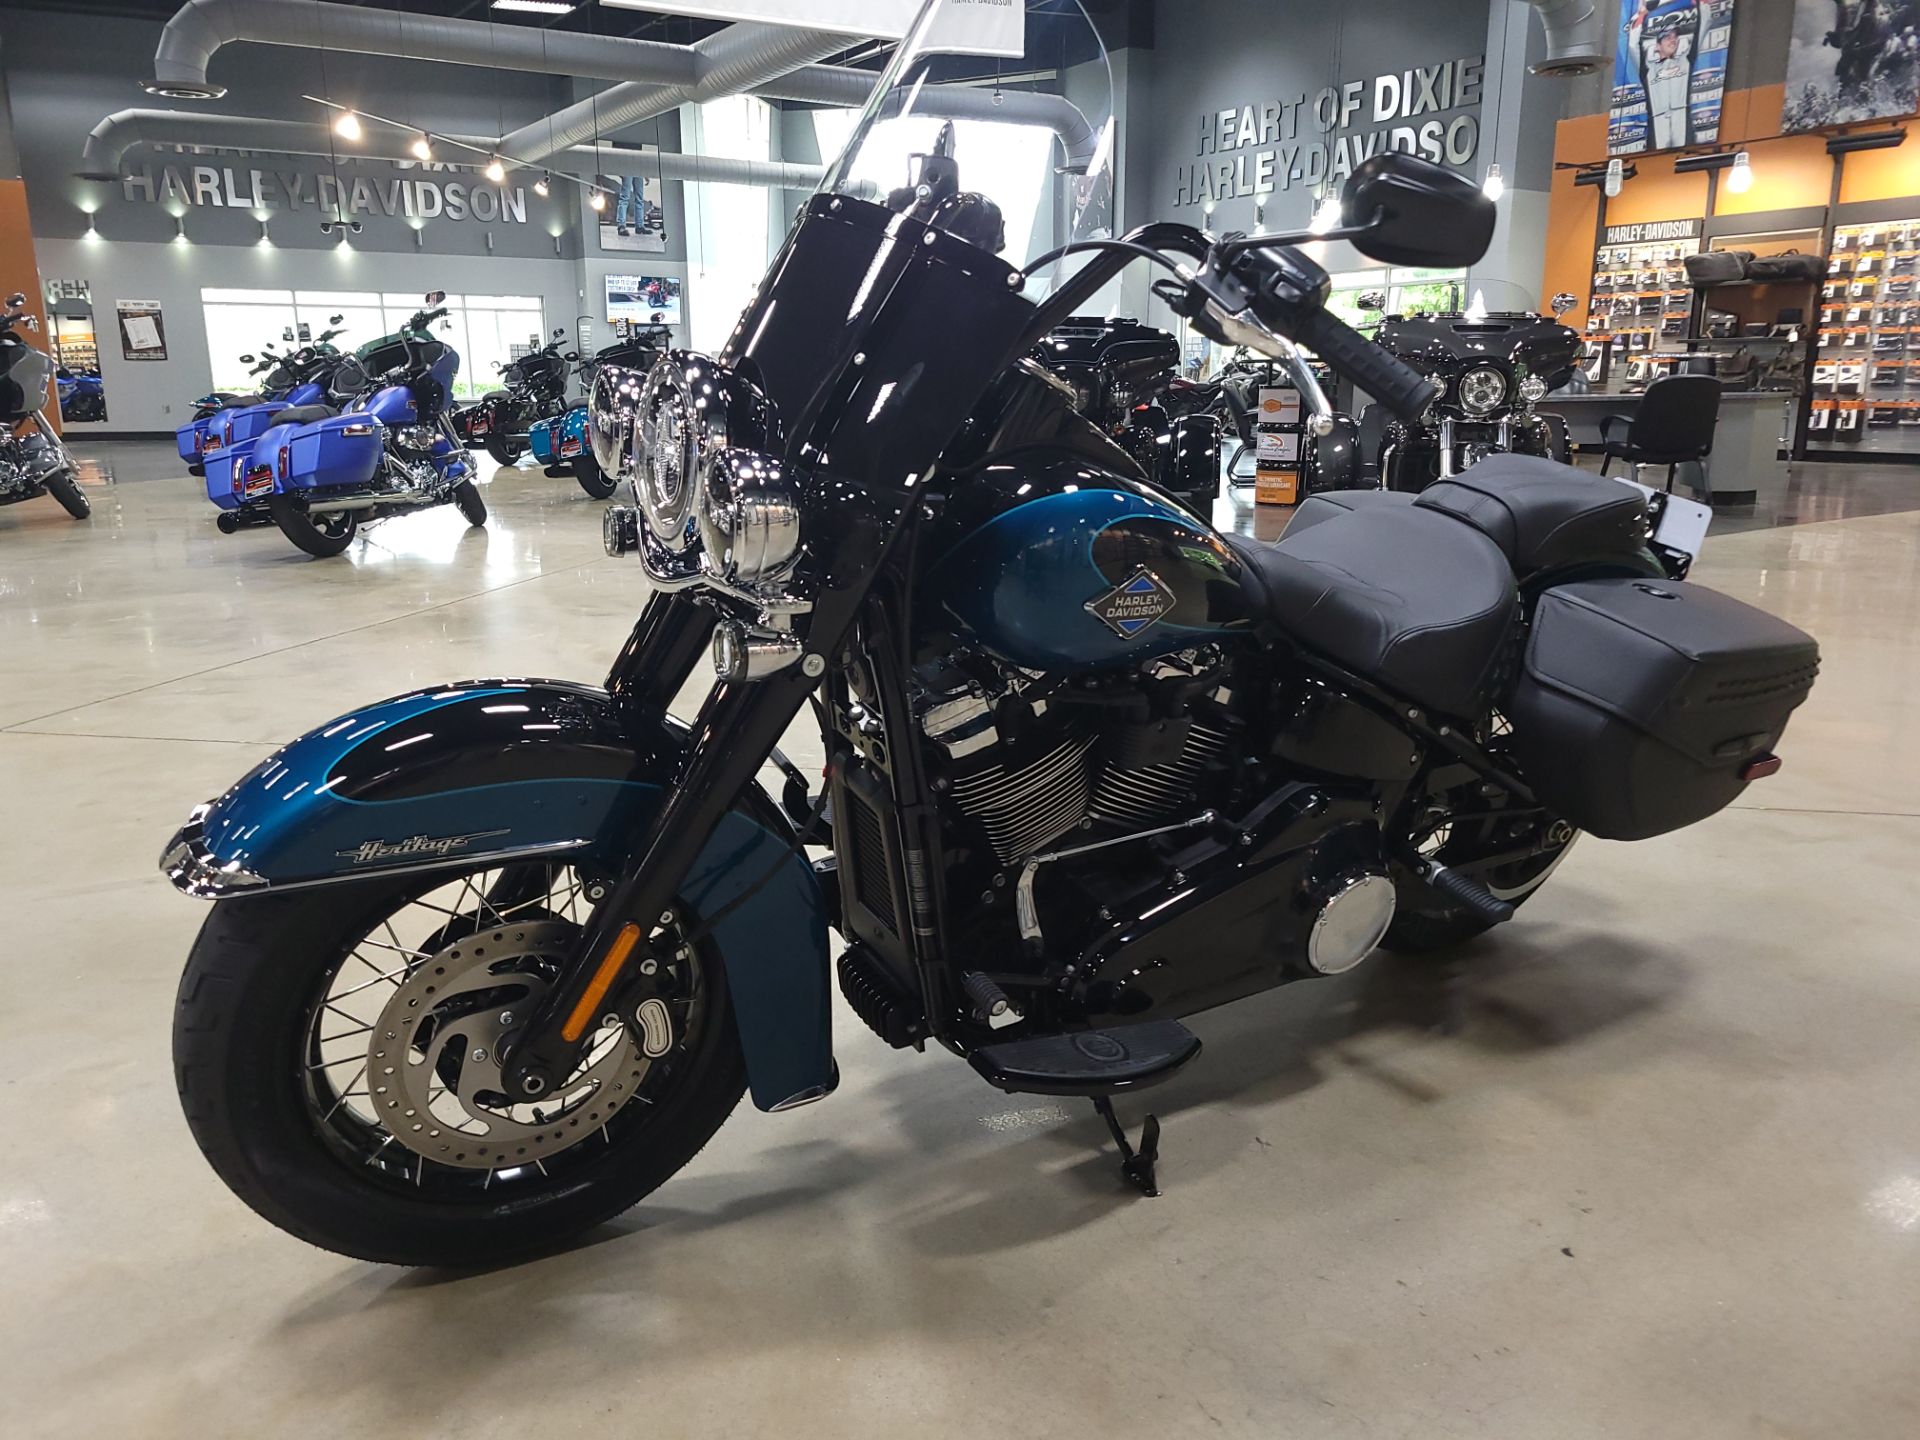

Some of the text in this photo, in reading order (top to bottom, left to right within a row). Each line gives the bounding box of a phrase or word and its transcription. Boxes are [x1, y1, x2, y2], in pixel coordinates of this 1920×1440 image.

[1196, 54, 1485, 157] HEART OF DIXIE
[122, 163, 528, 224] HARLEY-DAVIDSON
[1607, 220, 1694, 243] HARLEY-DAVIDSON
[1106, 604, 1164, 618] DAVIDSON
[1115, 594, 1162, 607] HARLEY-
[353, 835, 469, 864] Heritage
